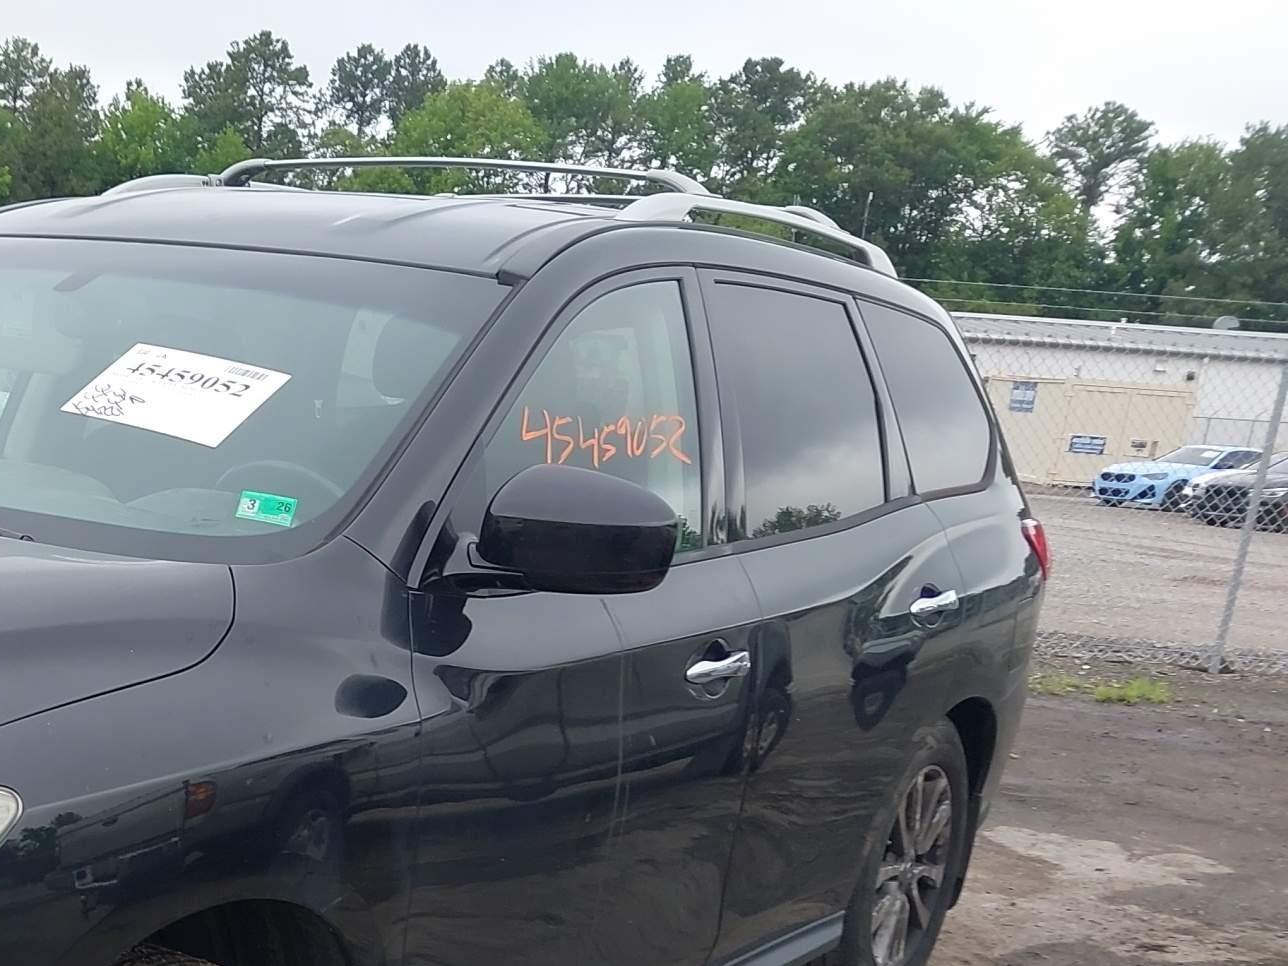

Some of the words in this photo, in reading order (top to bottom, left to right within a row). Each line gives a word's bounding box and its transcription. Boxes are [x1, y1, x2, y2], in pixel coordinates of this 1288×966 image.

[126, 362, 250, 398] 45459052
[520, 405, 692, 469] 45459052
[276, 501, 293, 513] 26
